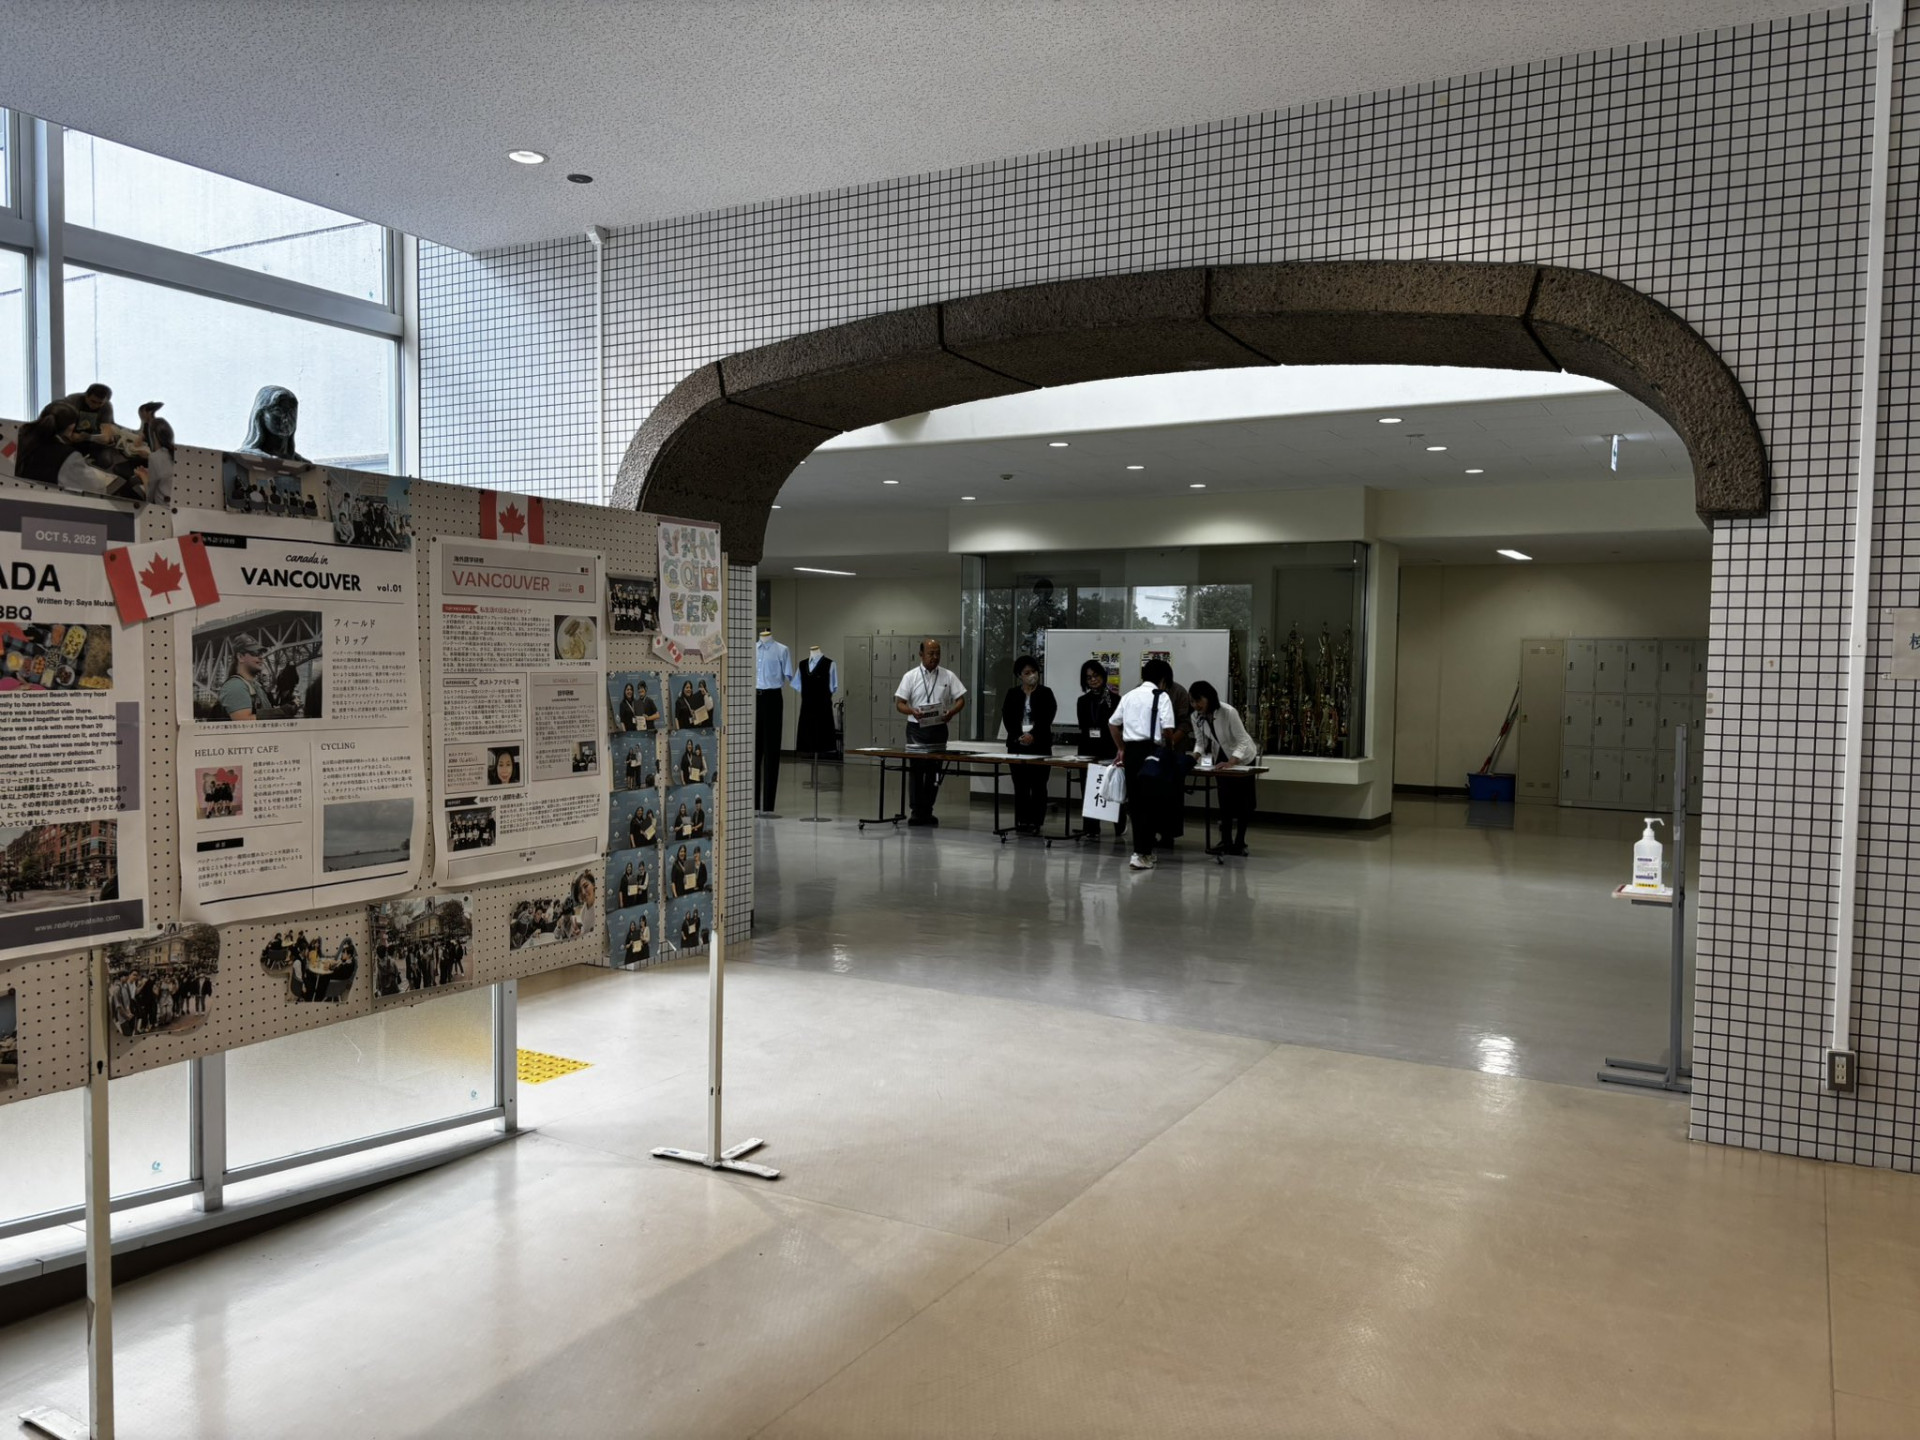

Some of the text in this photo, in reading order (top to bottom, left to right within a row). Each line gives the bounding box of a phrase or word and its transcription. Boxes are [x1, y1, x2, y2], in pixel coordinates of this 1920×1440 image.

[35, 530, 97, 545] OCT 5, 2025
[285, 552, 329, 565] canada in
[240, 566, 402, 593] VANCOUVER vol.01
[452, 570, 585, 594] VANCOUVER 8
[36, 596, 63, 606] Written
[64, 597, 75, 607] by:
[76, 599, 92, 608] Saya
[333, 618, 376, 629] フィールド
[673, 623, 709, 636] REPORT
[334, 635, 369, 646] トリップ
[194, 745, 279, 757] HELLO KITTY CAFE
[321, 742, 356, 751] CYCLING
